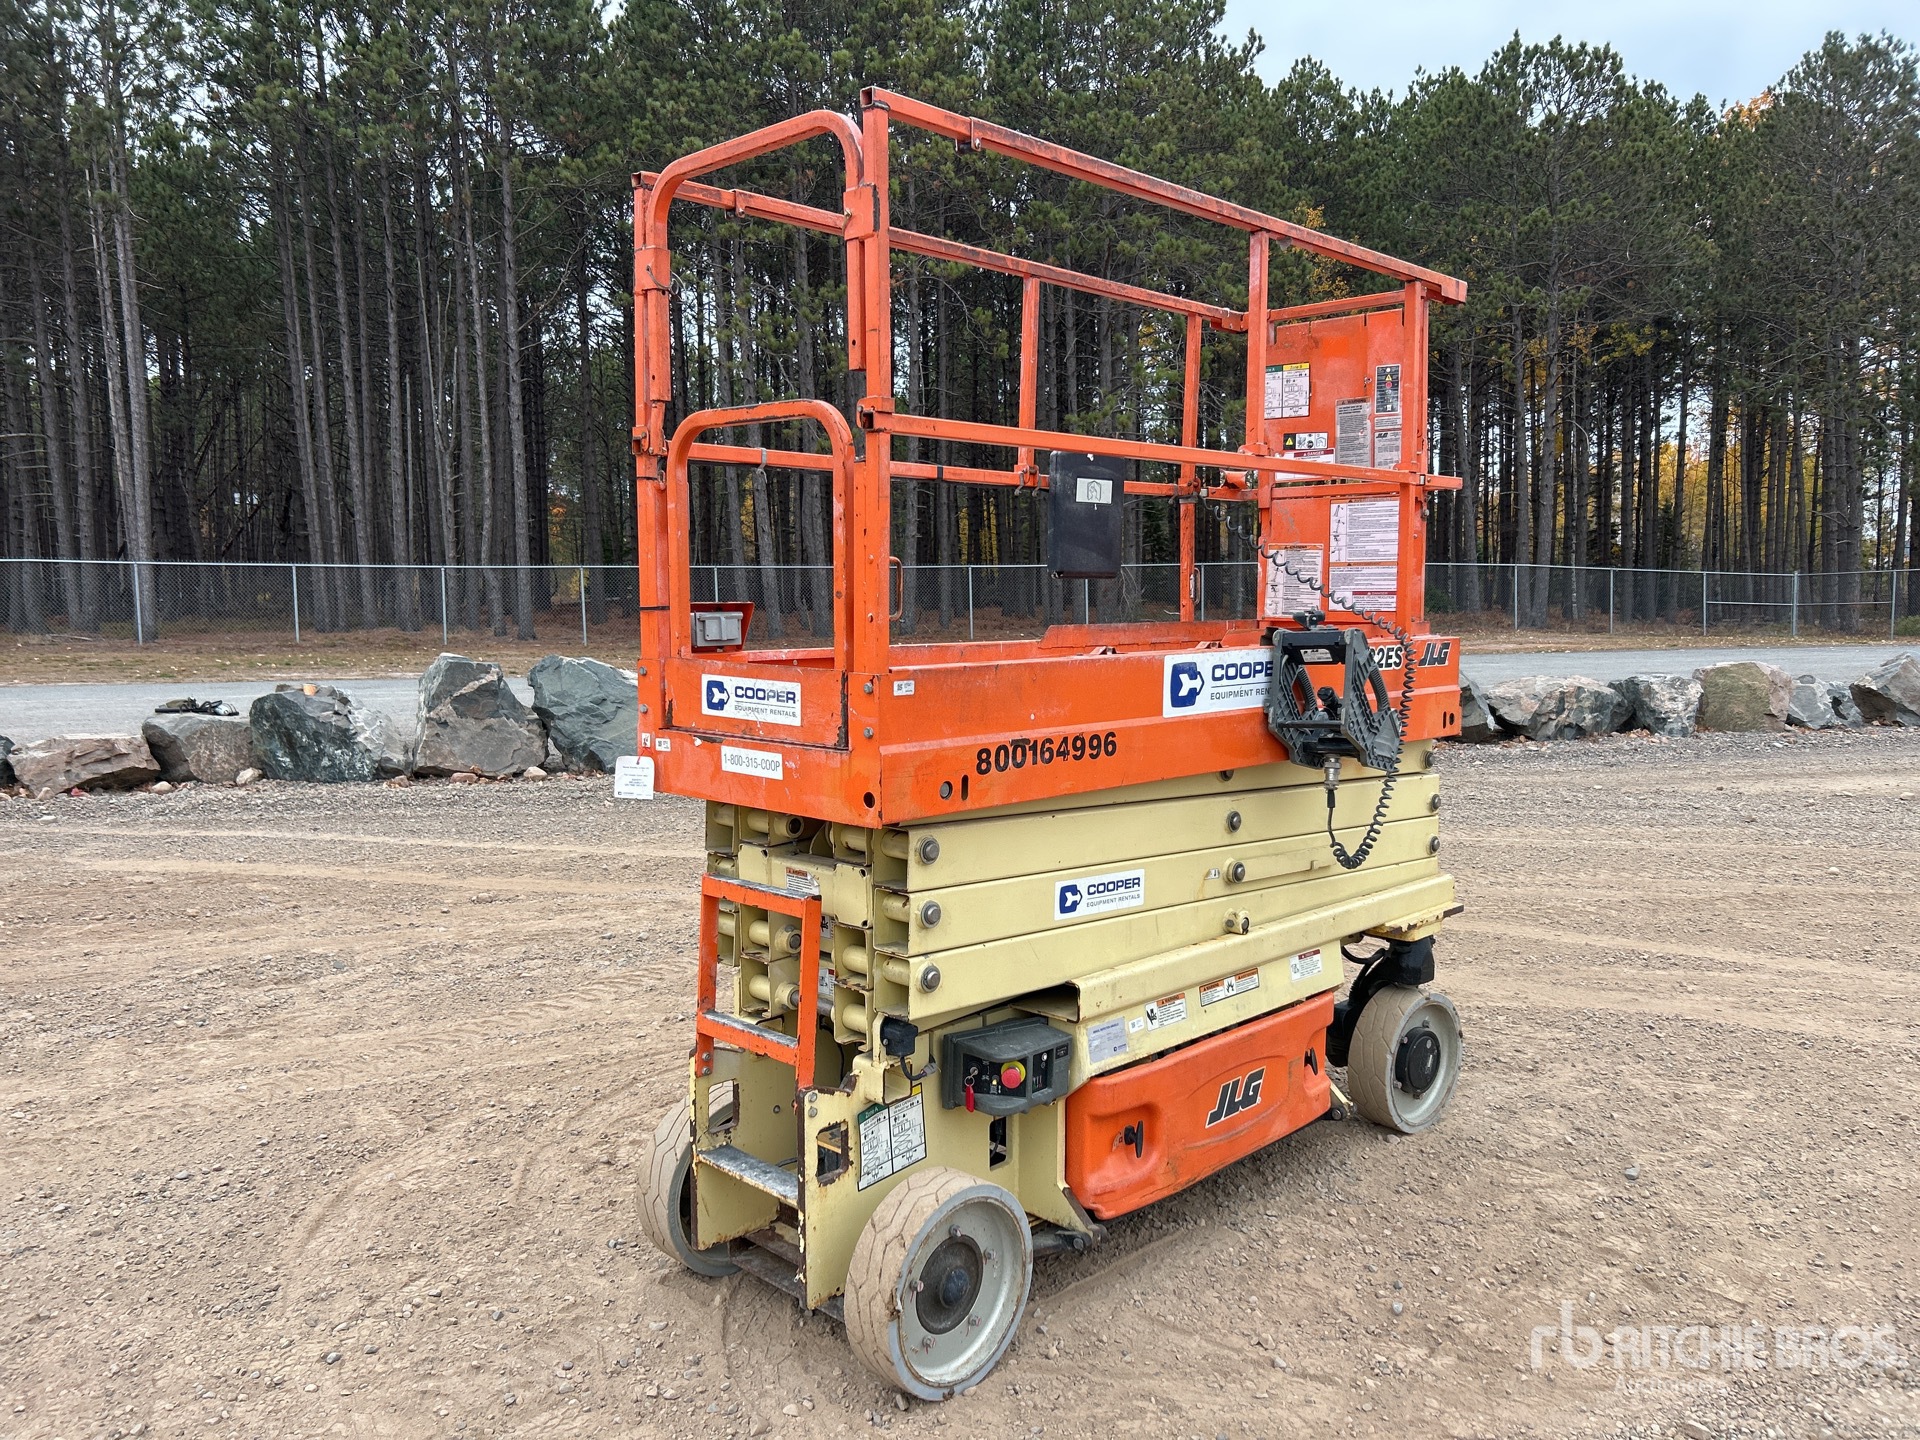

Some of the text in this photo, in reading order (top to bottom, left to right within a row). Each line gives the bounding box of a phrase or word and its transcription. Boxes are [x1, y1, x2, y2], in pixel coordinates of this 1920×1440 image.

[1418, 642, 1451, 667] JLG
[1211, 661, 1274, 682] COOPE
[735, 686, 796, 704] COOPER
[1210, 688, 1254, 701] EQUIPMENT
[734, 704, 768, 715] EQUIPMENT
[724, 753, 781, 772] 1-800-315-COOP
[976, 731, 1117, 775] 800164996
[1087, 876, 1141, 896] COOPER
[1086, 893, 1140, 908] EQUIPMENT RENTALS
[1205, 1066, 1266, 1129] JLG
